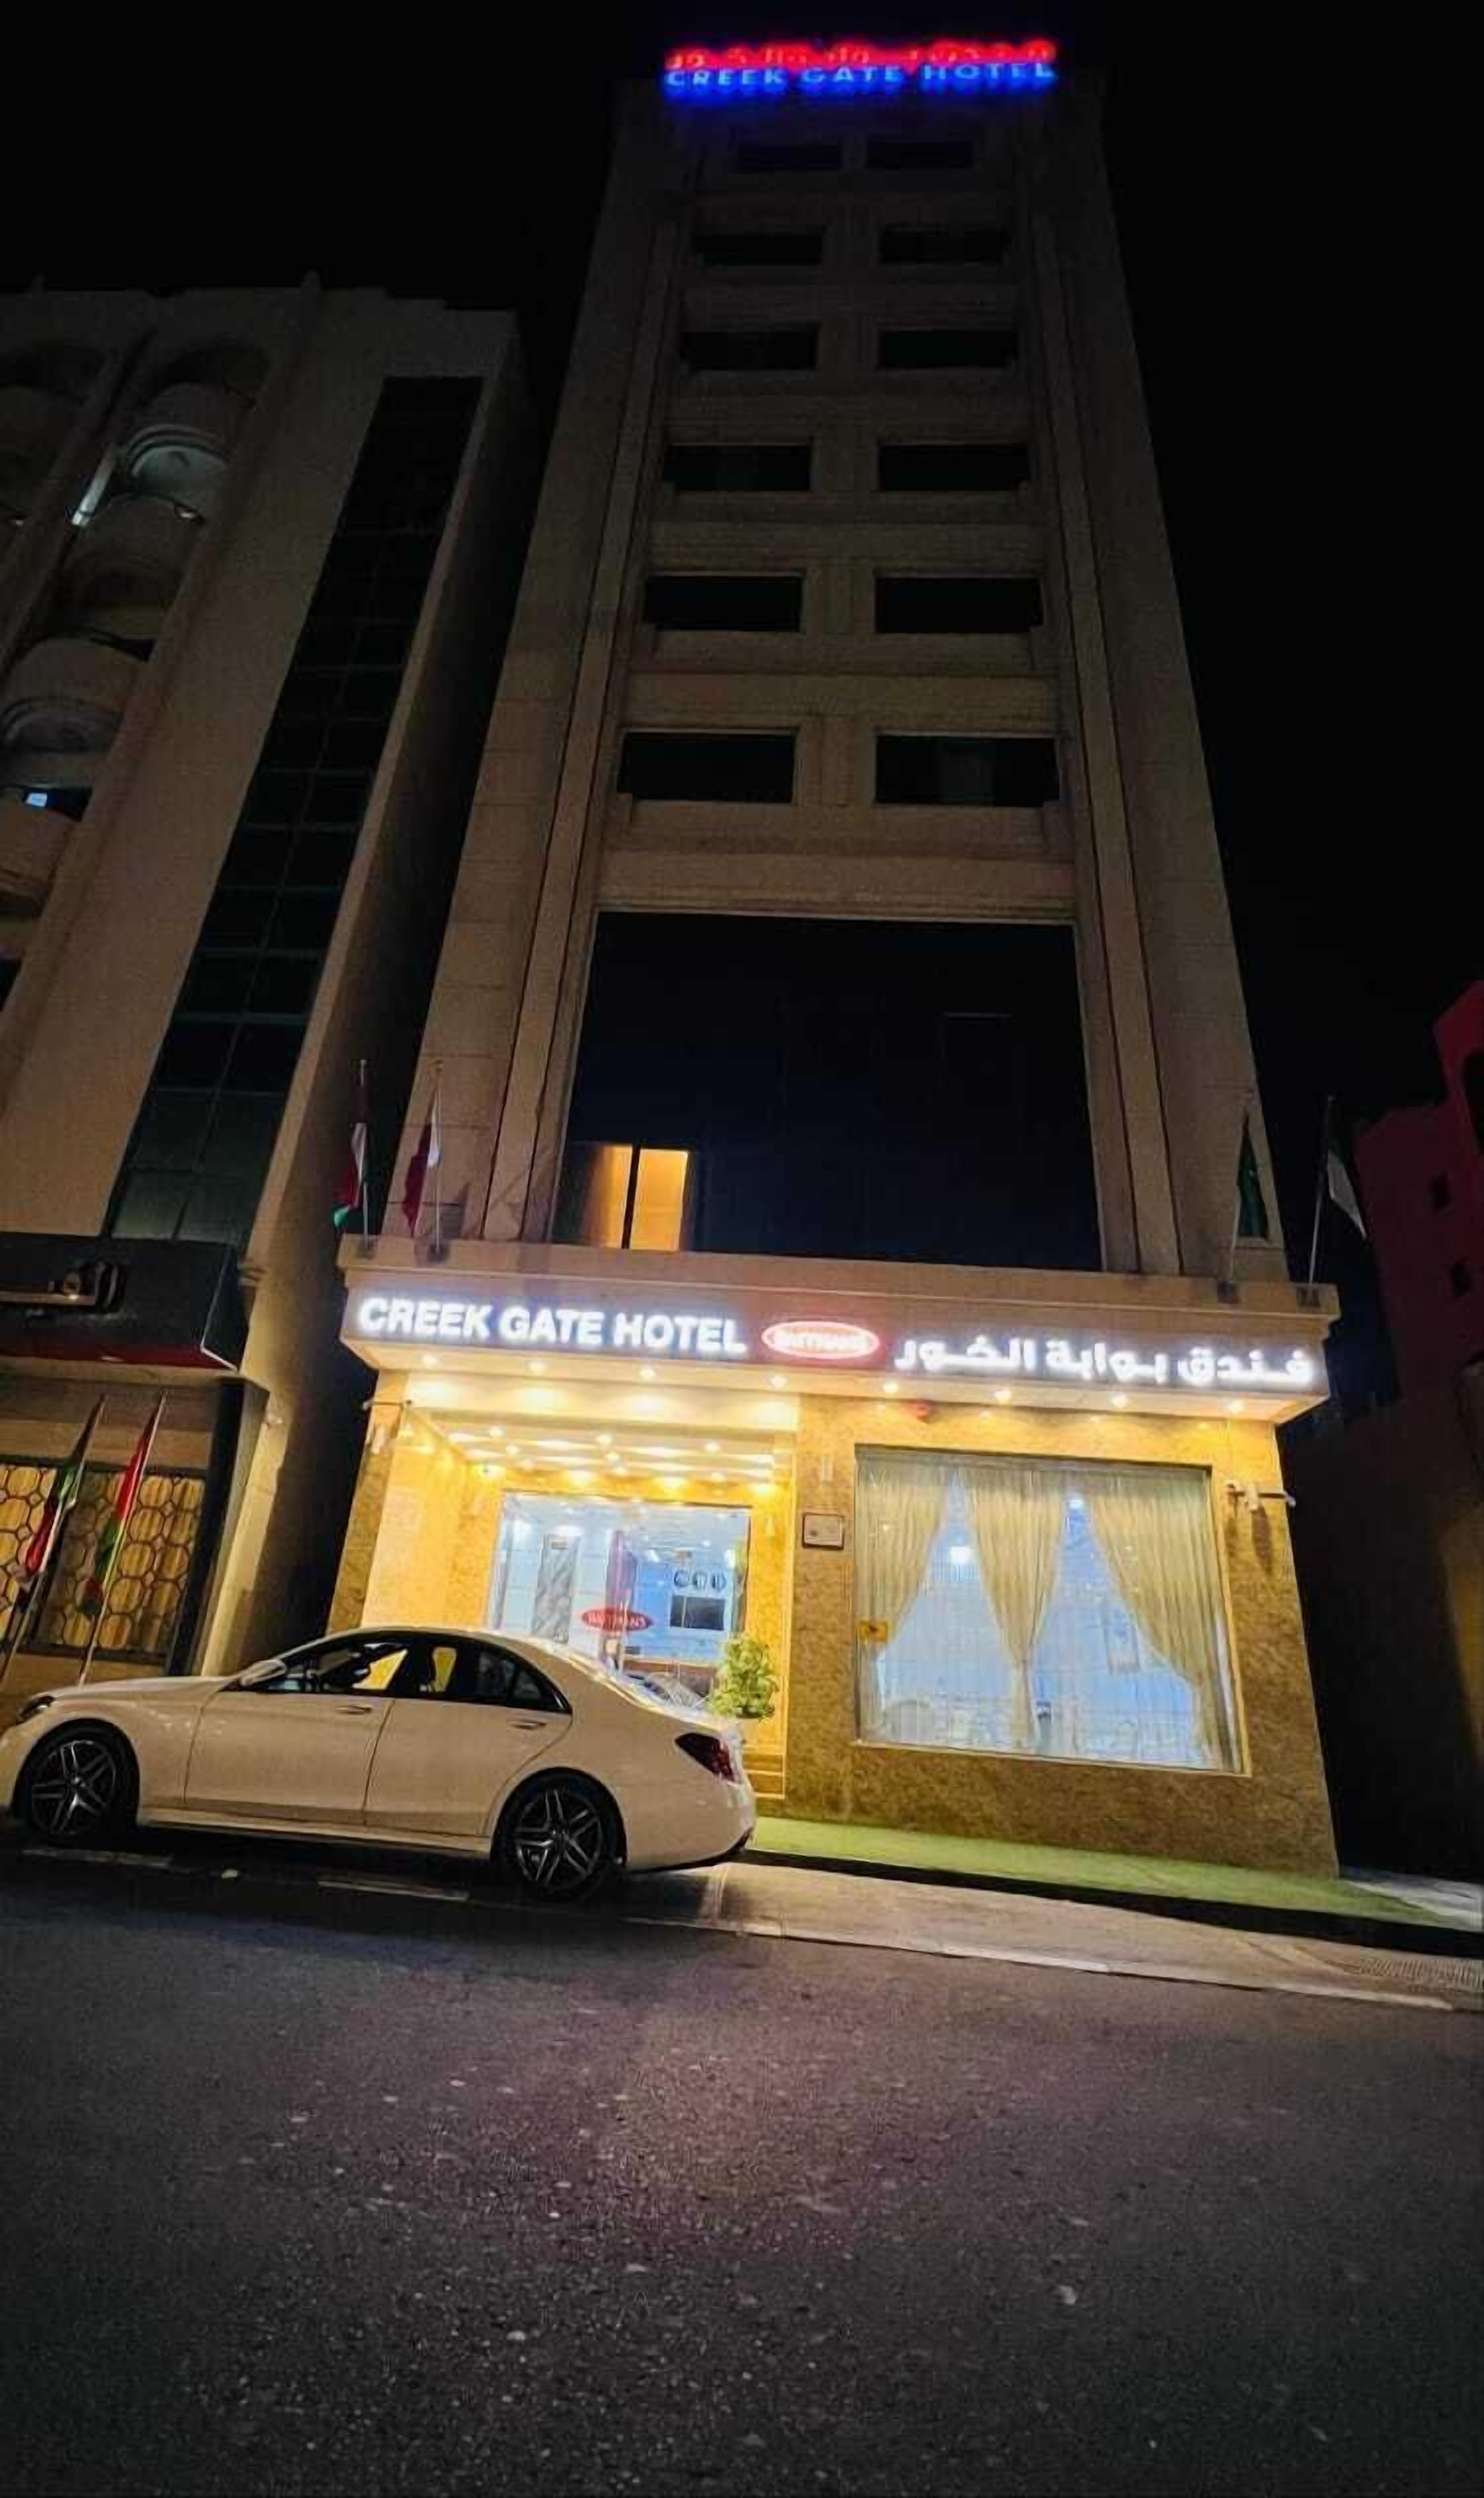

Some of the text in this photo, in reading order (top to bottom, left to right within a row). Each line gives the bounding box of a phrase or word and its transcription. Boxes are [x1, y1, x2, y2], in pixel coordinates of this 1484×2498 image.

[666, 62, 1055, 87] CREEK GATE HOTEL
[359, 1296, 492, 1338] CREEK
[499, 1305, 604, 1345] GATE
[613, 1313, 747, 1353] HOTEL
[894, 1334, 1037, 1374] الخور
[1045, 1337, 1169, 1384] بوابة
[1177, 1346, 1314, 1385] فندق
